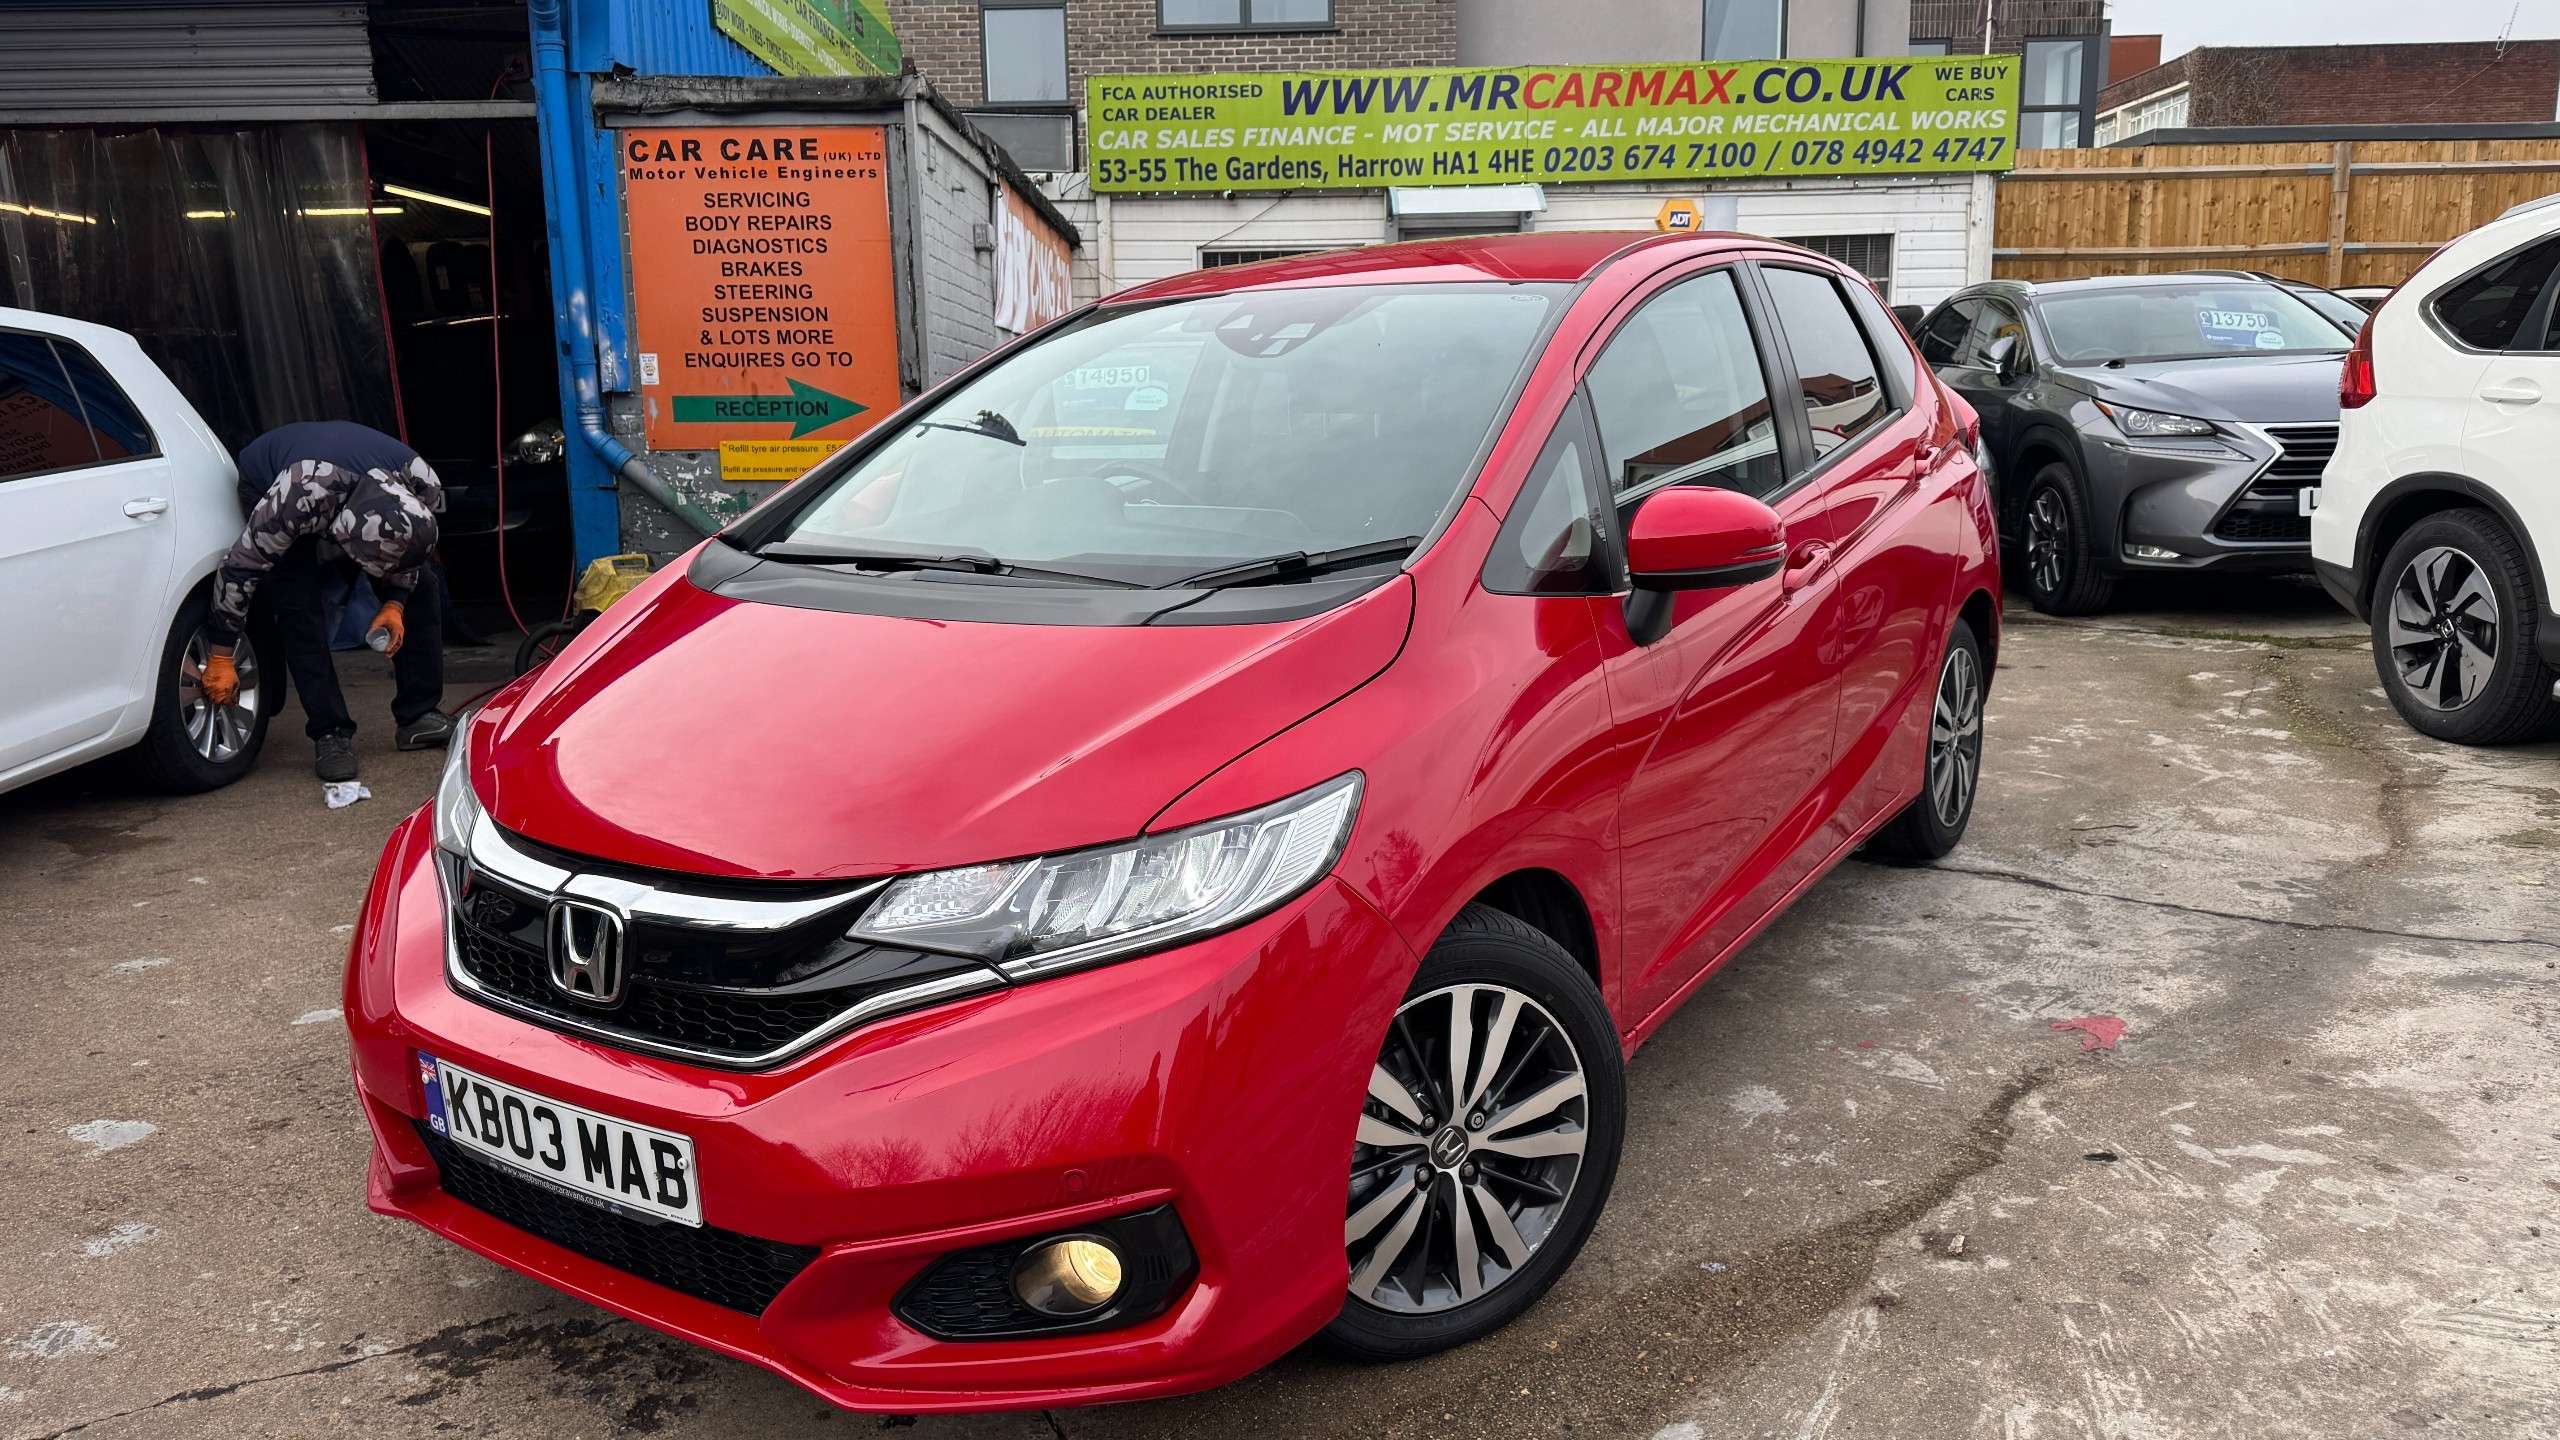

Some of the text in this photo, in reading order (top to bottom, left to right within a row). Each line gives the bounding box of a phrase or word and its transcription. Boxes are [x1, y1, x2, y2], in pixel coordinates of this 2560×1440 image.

[1935, 66, 2008, 81] WE BUY
[1102, 84, 1262, 101] FCA AUTHORISED
[1282, 66, 1912, 116] WWW.MRCARMAX.CO.UK
[1945, 87, 1995, 101] CARS
[1102, 106, 1215, 121] CAR DEALER
[1099, 129, 1148, 150] CAR
[1156, 128, 1234, 149] SALES
[1243, 125, 1357, 148] FINANCE
[1383, 123, 1439, 144] MOT
[1444, 120, 1556, 142] SERVICE
[1581, 117, 1627, 138] ALL
[1636, 114, 1724, 136] MAJOR
[1731, 111, 1901, 134] MECHANICAL
[1911, 109, 2007, 130] WORKS
[628, 138, 881, 163] CAR CARE (UK) LTD
[1099, 157, 1166, 183] 53-55
[1174, 157, 1217, 182] The
[1226, 154, 1329, 185] Gardens,
[1339, 152, 1424, 178] Harrow
[1433, 150, 1478, 175] HA1
[1488, 149, 1534, 174] 4HE
[1544, 144, 1614, 171] 0203
[1624, 143, 1676, 170] 674
[1686, 141, 1756, 168] 7100
[1791, 139, 1844, 165] 078
[1852, 137, 1922, 163] 4942
[1932, 136, 2006, 161] 4747
[630, 166, 877, 182] Motor Vehicle Engineers
[704, 192, 811, 210] SERVICING
[685, 215, 832, 232] BODY REPAIRS
[1670, 213, 1691, 226] ADT
[693, 238, 828, 255] DIAGNOSTICS
[721, 261, 803, 278] BRAKES
[714, 284, 813, 301] STEERING
[702, 307, 829, 324] SUSPENSION
[700, 329, 834, 346] & LOTS MORE
[685, 351, 853, 370] ENQUIRES GO TO
[715, 401, 829, 417] RECEPTION
[728, 444, 749, 453] Refill
[751, 444, 767, 455] tyre
[769, 445, 781, 453] air
[782, 445, 819, 455] pressure
[430, 1113, 447, 1133] GB
[445, 1070, 689, 1210] KB03 MAB
